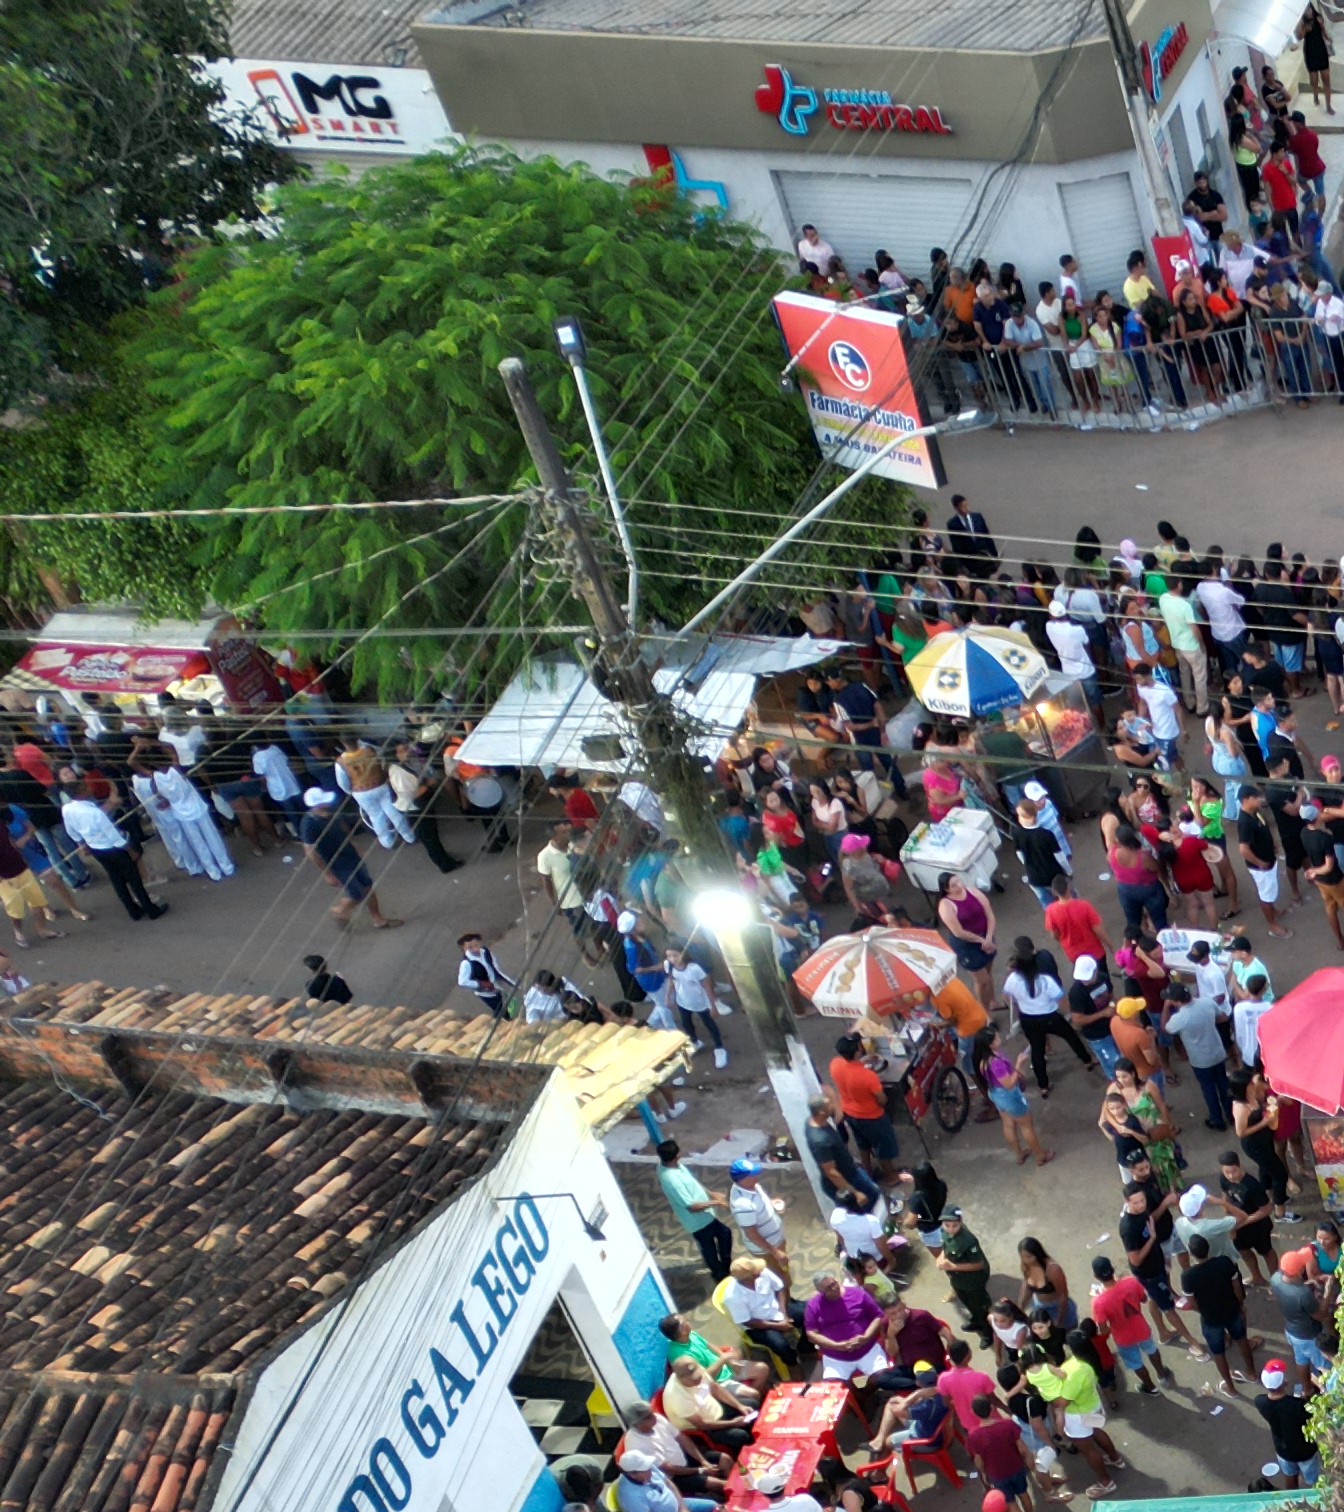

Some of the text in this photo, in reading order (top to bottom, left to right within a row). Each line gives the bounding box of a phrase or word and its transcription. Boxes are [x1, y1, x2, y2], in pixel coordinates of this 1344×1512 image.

[291, 71, 393, 119] MG
[823, 87, 892, 105] FARMÁCIA
[310, 117, 400, 135] SMART
[825, 102, 953, 135] CENTRAL
[834, 346, 865, 388] FC
[808, 390, 872, 422] Farmácia
[874, 406, 917, 434] Cunha
[863, 443, 922, 466] BAATEIRA
[1024, 666, 1047, 693] Kibon
[928, 698, 968, 713] Kibon
[821, 1005, 863, 1017] ITAIPAVA
[400, 1191, 551, 1460] GALEGO
